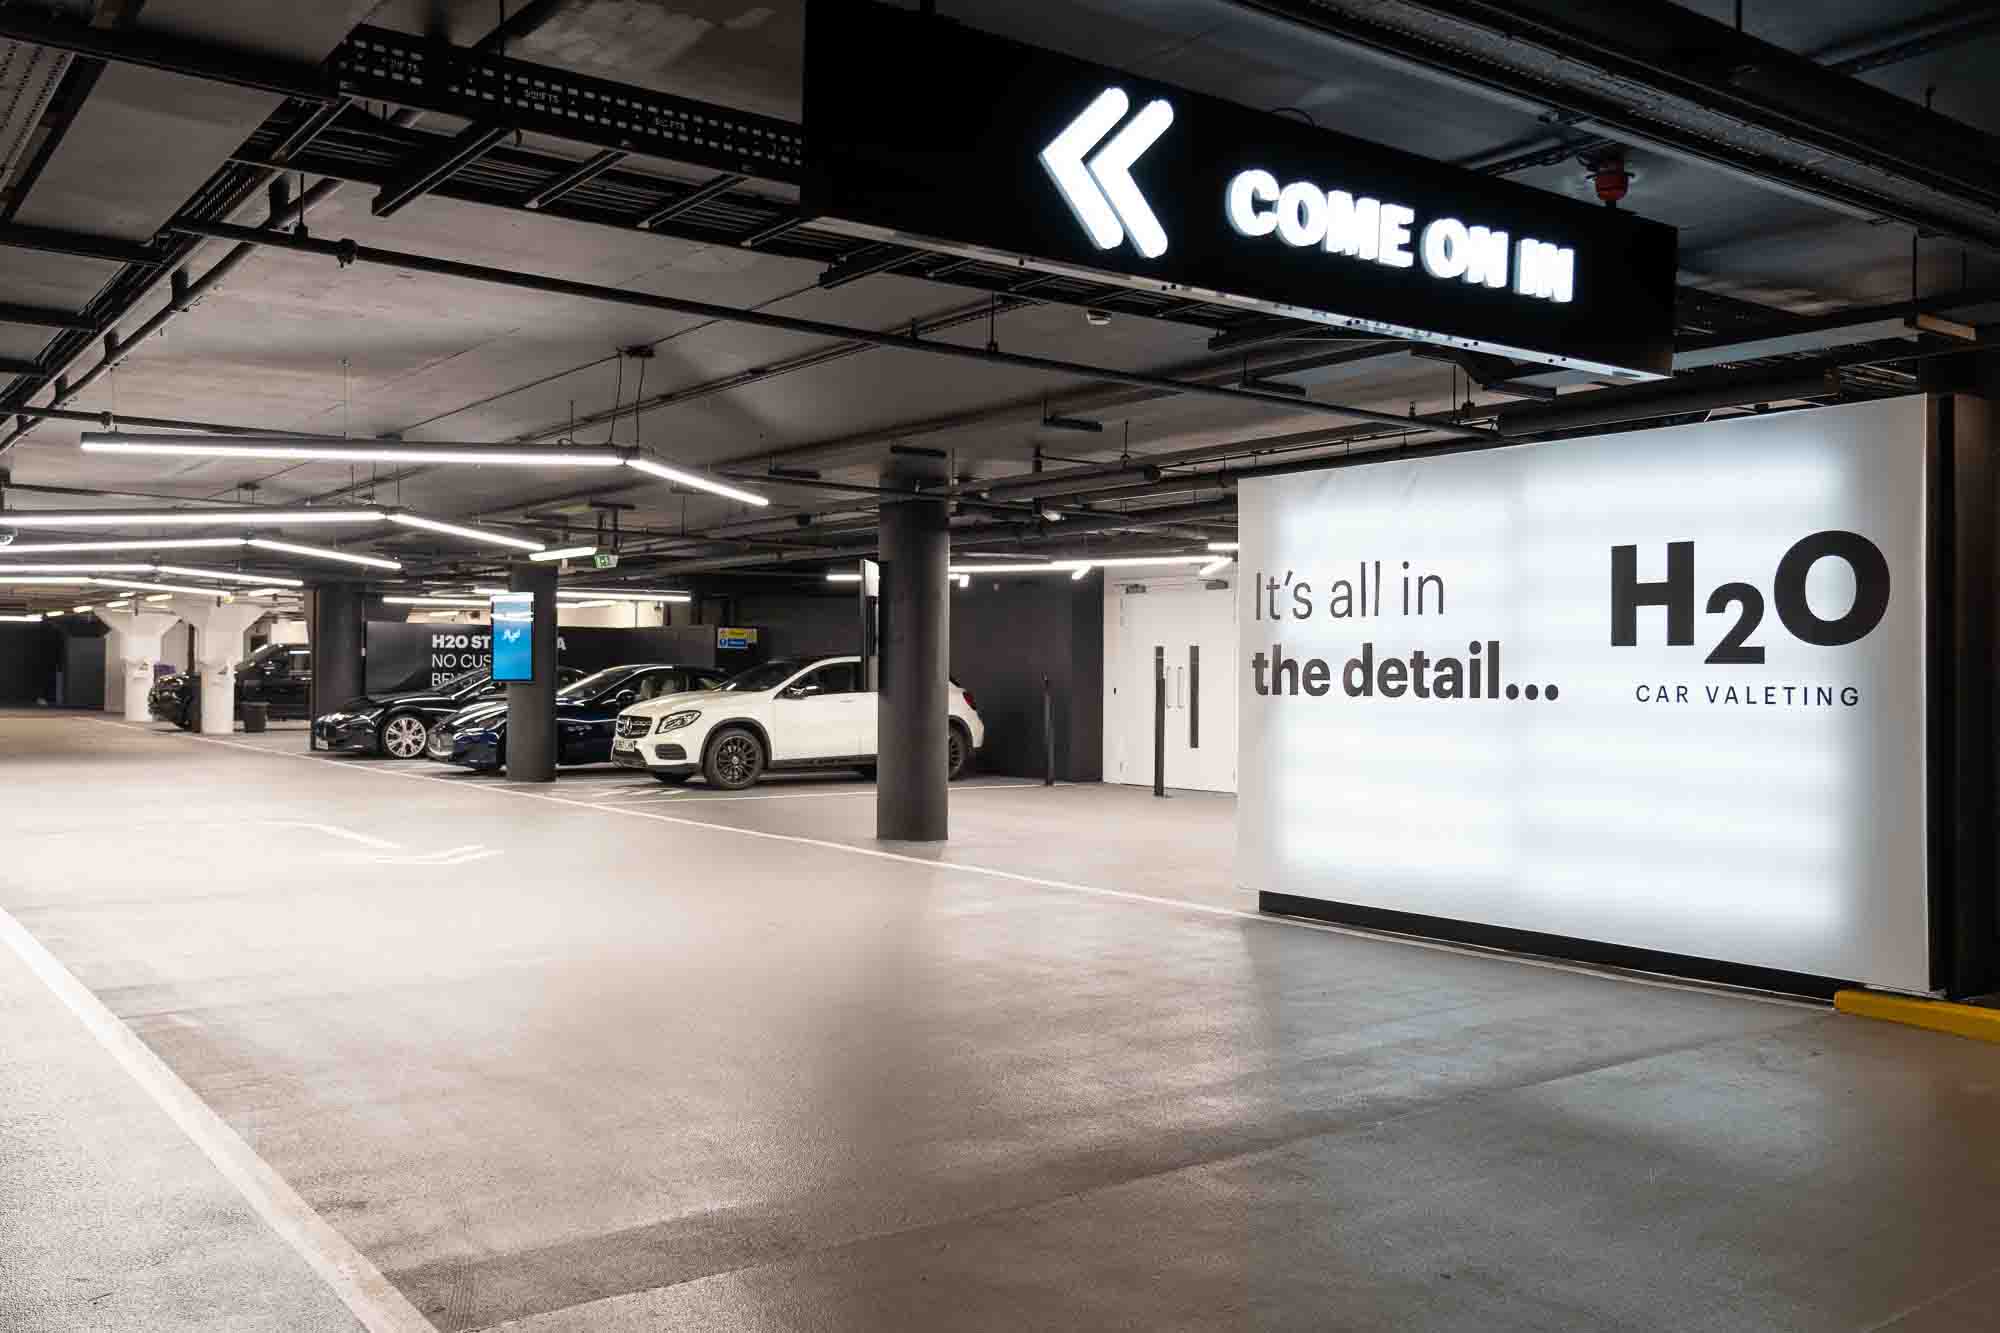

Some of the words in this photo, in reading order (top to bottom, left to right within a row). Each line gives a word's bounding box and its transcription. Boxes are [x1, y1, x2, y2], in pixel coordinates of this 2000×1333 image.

[1224, 168, 1415, 269] COME
[1419, 217, 1509, 289] ON
[1512, 237, 1575, 303] IN
[1255, 570, 1314, 621] It's
[1329, 560, 1381, 619] all
[1402, 560, 1445, 617] in
[1610, 530, 1891, 665] H2O
[431, 634, 469, 649] H2O
[431, 653, 457, 668] NO
[1251, 643, 1332, 698] the
[1342, 640, 1560, 702] detail...
[1635, 684, 1690, 704] CAR
[1704, 685, 1860, 708] VALETING
